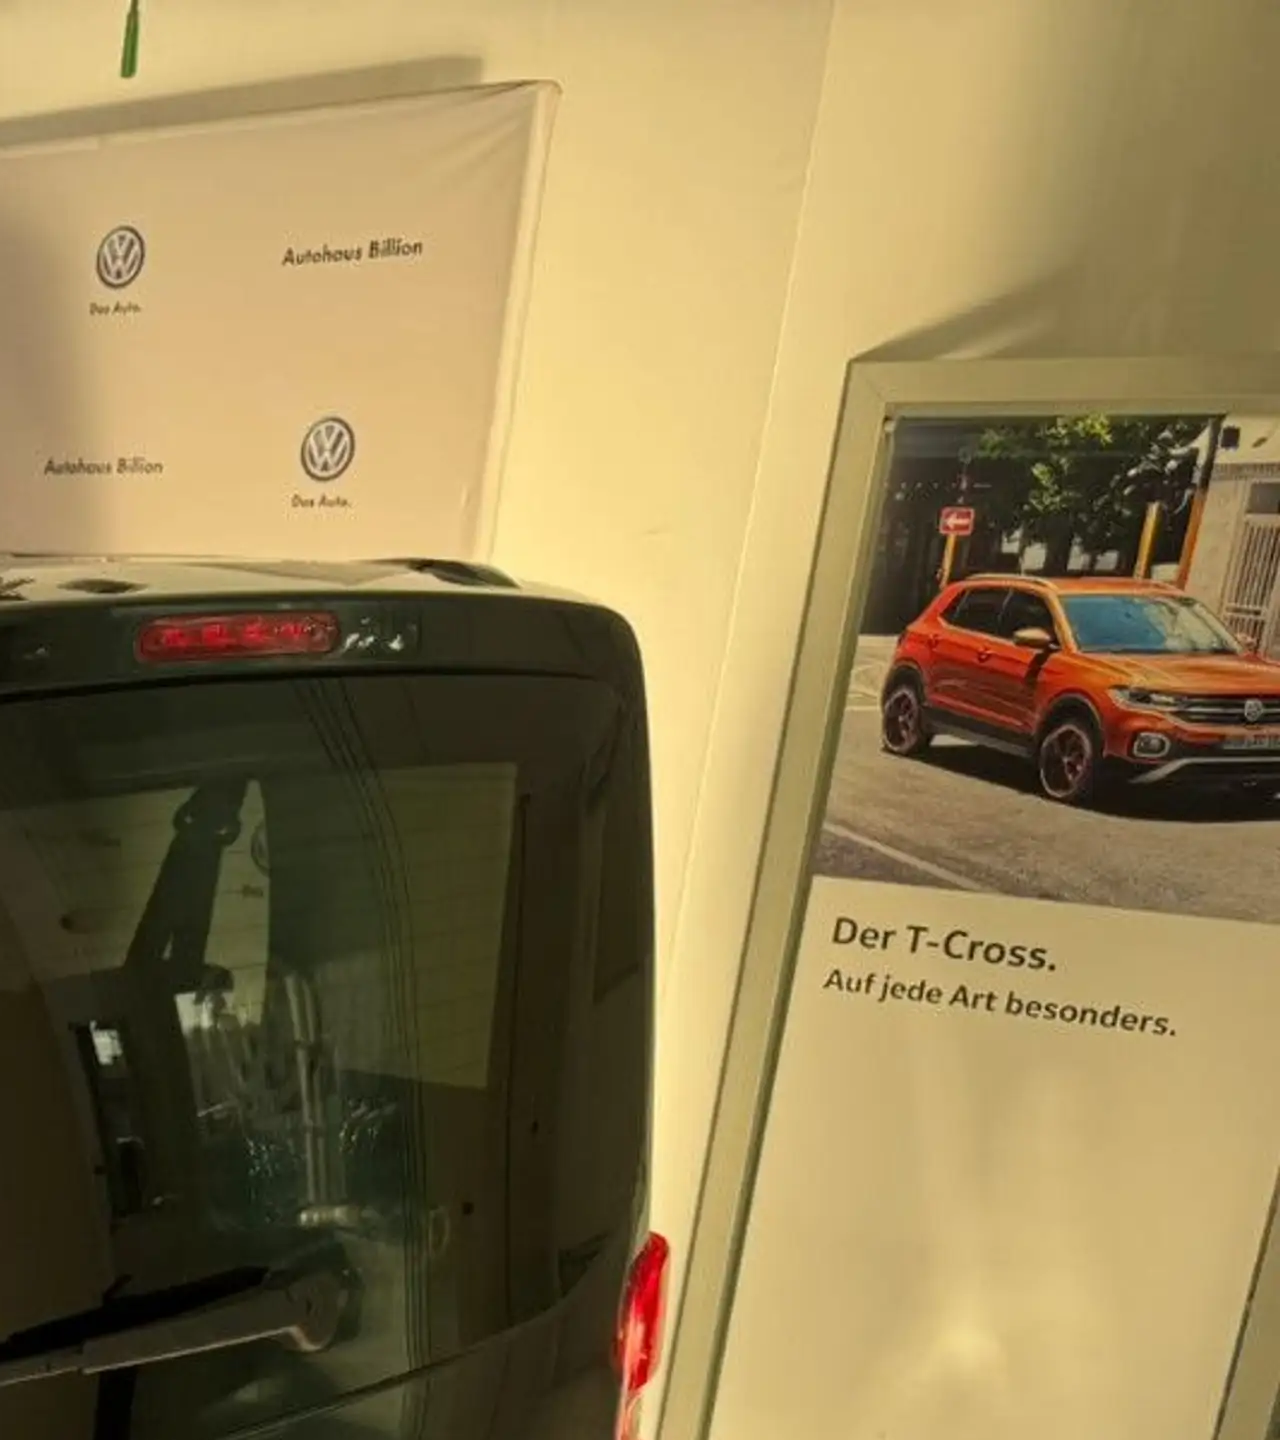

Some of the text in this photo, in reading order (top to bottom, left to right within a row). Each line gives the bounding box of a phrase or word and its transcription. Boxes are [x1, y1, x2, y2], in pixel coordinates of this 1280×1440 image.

[282, 238, 423, 266] Autohaus Billion
[44, 456, 163, 475] Autohaus Billion
[831, 917, 1057, 973] Der T-Cross.
[823, 969, 1177, 1037] Auf jede Art besonders.
